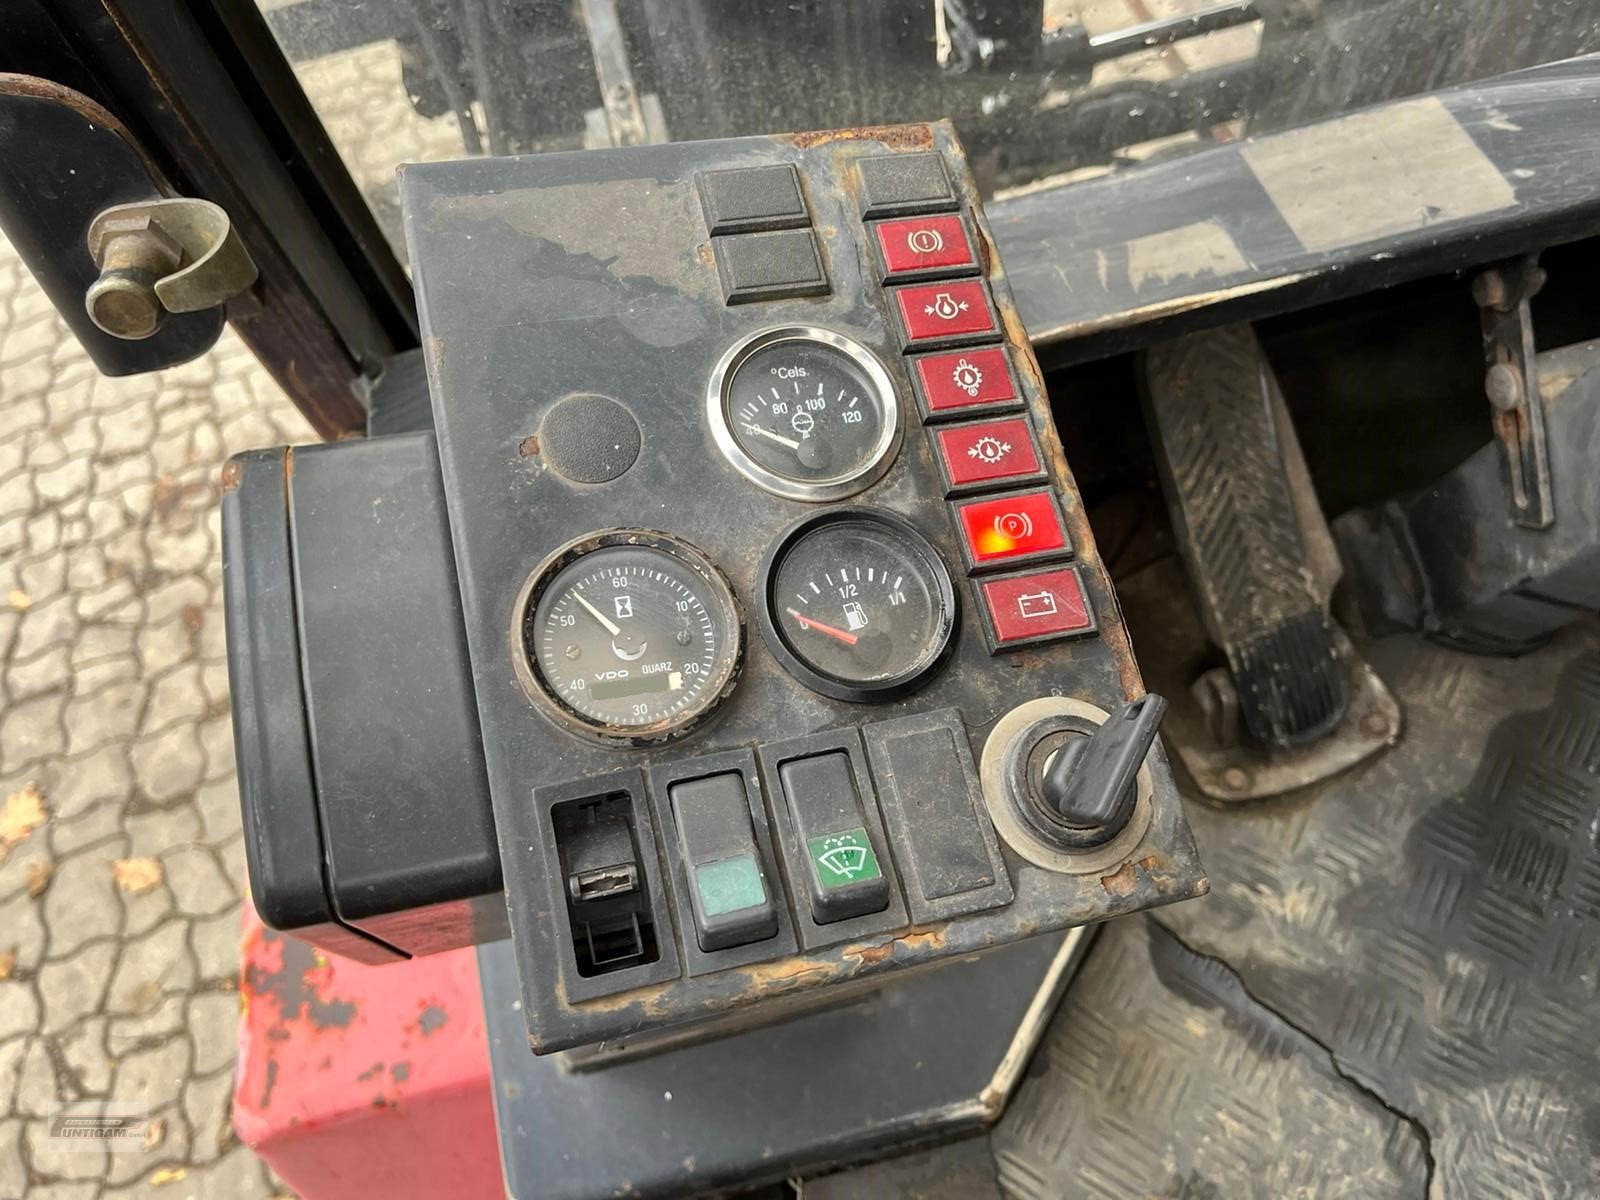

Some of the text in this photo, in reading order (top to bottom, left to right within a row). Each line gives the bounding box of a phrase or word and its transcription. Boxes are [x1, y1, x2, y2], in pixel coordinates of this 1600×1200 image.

[772, 402, 788, 415] 80
[805, 397, 826, 411] 100
[842, 410, 862, 423] 120
[612, 577, 628, 588] 60
[838, 584, 859, 599] 1/2
[676, 601, 688, 612] 10
[560, 615, 576, 627] 50
[684, 662, 699, 674] 20
[595, 669, 629, 680] VDO
[570, 679, 585, 690] 40
[632, 704, 648, 716] 30
